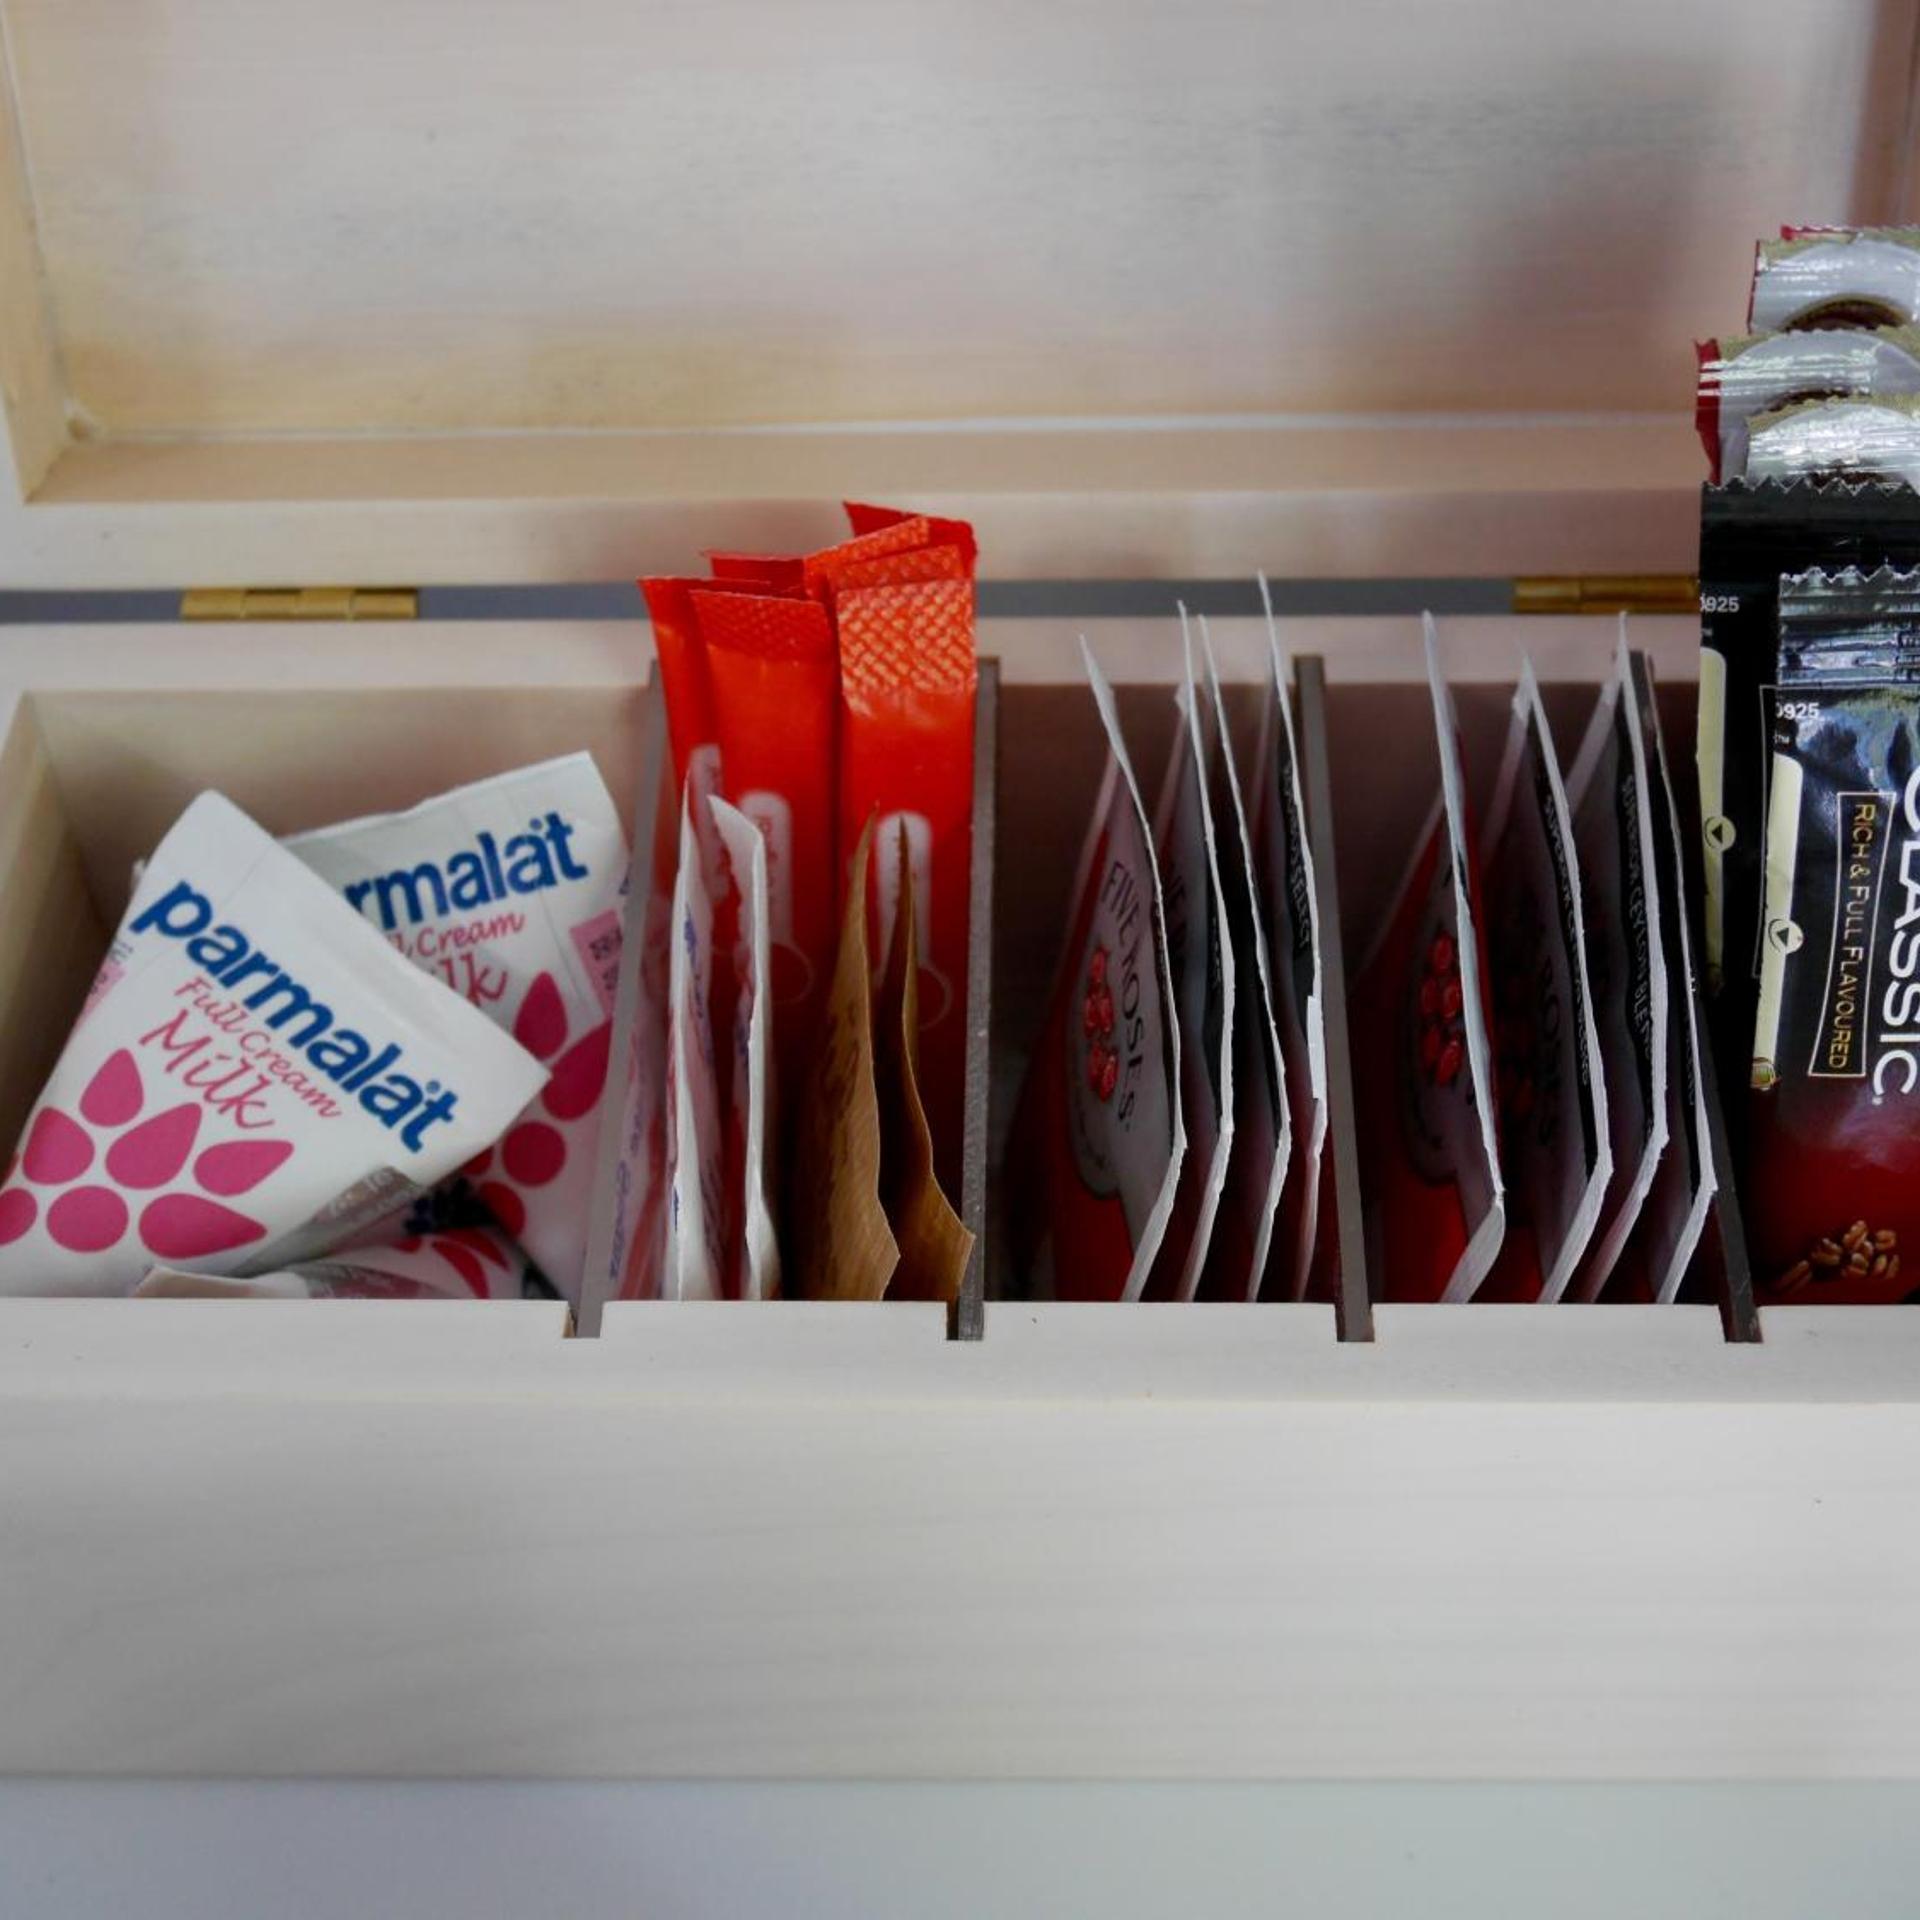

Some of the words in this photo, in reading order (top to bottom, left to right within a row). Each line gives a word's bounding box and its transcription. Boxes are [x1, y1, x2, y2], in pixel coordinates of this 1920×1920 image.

[343, 812, 588, 930] rmalat
[1850, 862, 1872, 878] &
[1852, 803, 1877, 858] RICH
[416, 911, 526, 958] Cream
[1843, 885, 1870, 940] FULL
[130, 880, 459, 1154] parmalat
[174, 977, 247, 1036] Full
[239, 1028, 342, 1118] Cream
[1827, 945, 1865, 1070] FLAVOURED
[138, 1009, 275, 1130] Milk
